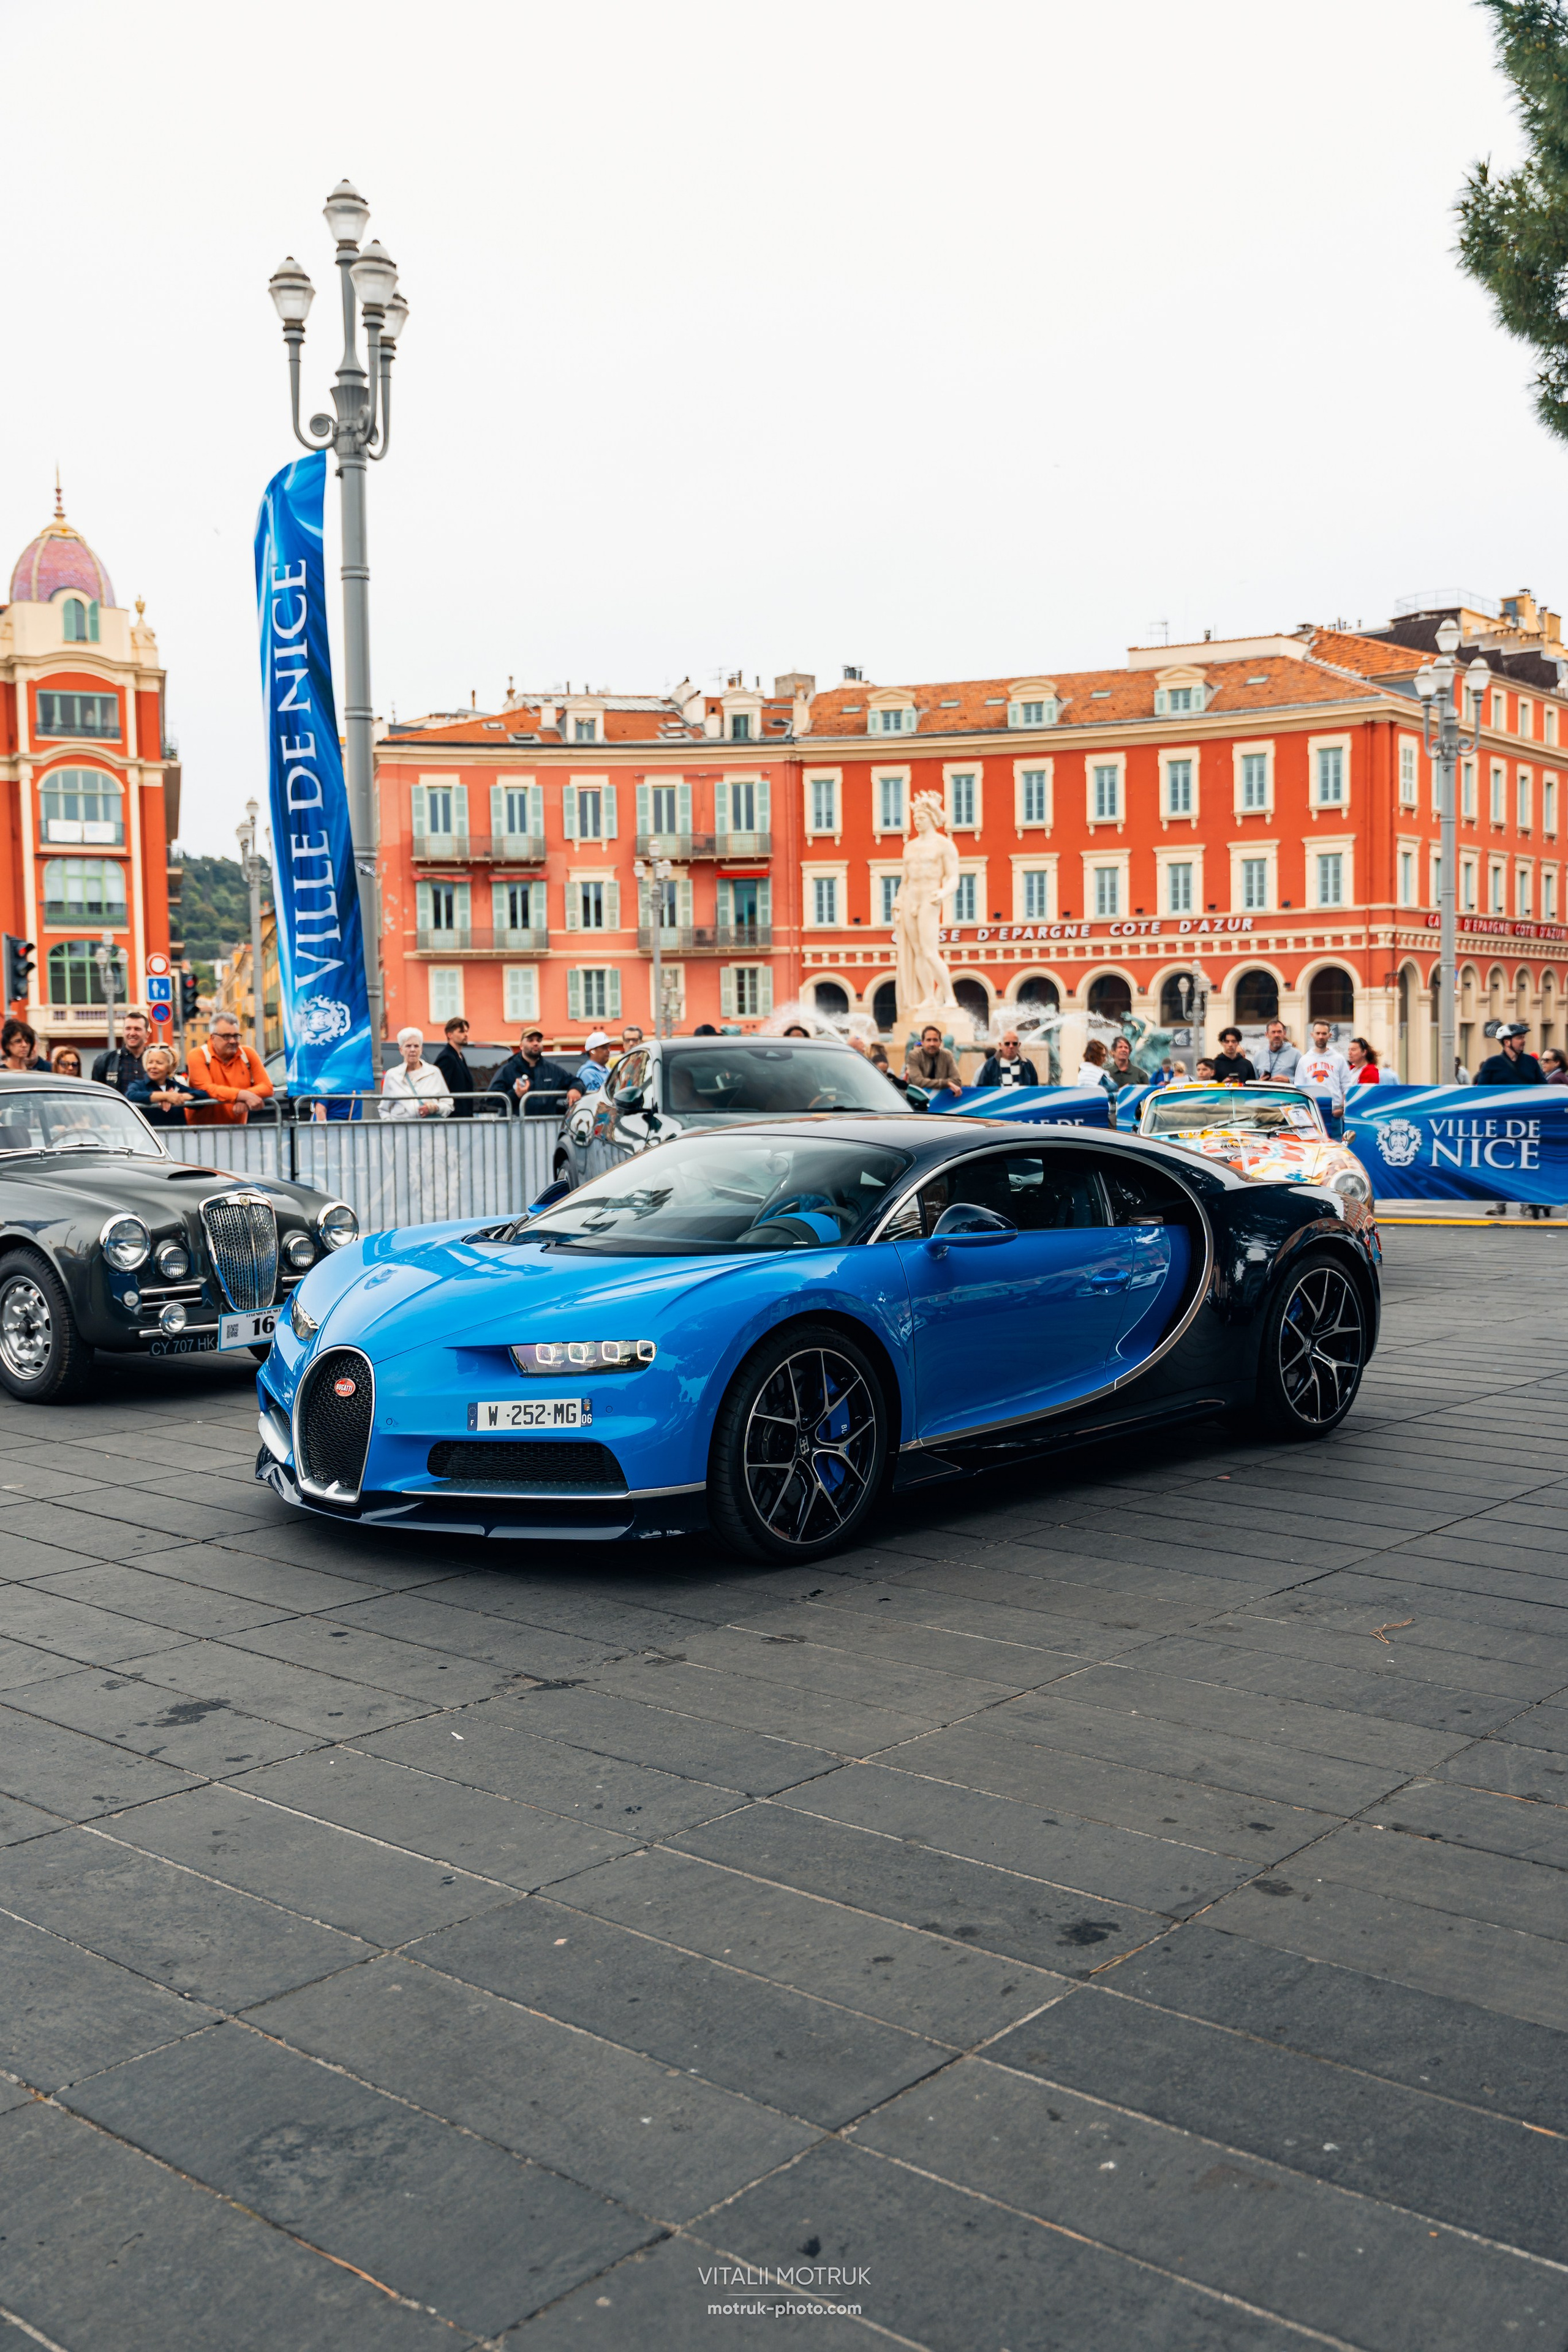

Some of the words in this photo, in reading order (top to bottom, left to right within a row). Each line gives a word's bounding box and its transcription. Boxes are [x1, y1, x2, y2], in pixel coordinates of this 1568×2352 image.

[271, 559, 311, 714] NICE
[281, 731, 323, 815] DE
[291, 829, 344, 992] VILLE
[976, 924, 1091, 942] D'EPARGNE
[1109, 921, 1162, 936] COTE
[1178, 918, 1254, 933] D'AZUR
[1463, 918, 1510, 935] D'EPARGNE
[1515, 924, 1536, 938] COTE
[1428, 1118, 1498, 1138] VILLE
[1505, 1119, 1542, 1139] DE
[1428, 1137, 1541, 1170] NICE
[252, 1316, 276, 1336] 16
[152, 1341, 170, 1355] CY
[173, 1339, 195, 1353] 707
[198, 1336, 216, 1351] HK
[336, 1383, 353, 1393] BUGATTI
[582, 1414, 592, 1424] 06
